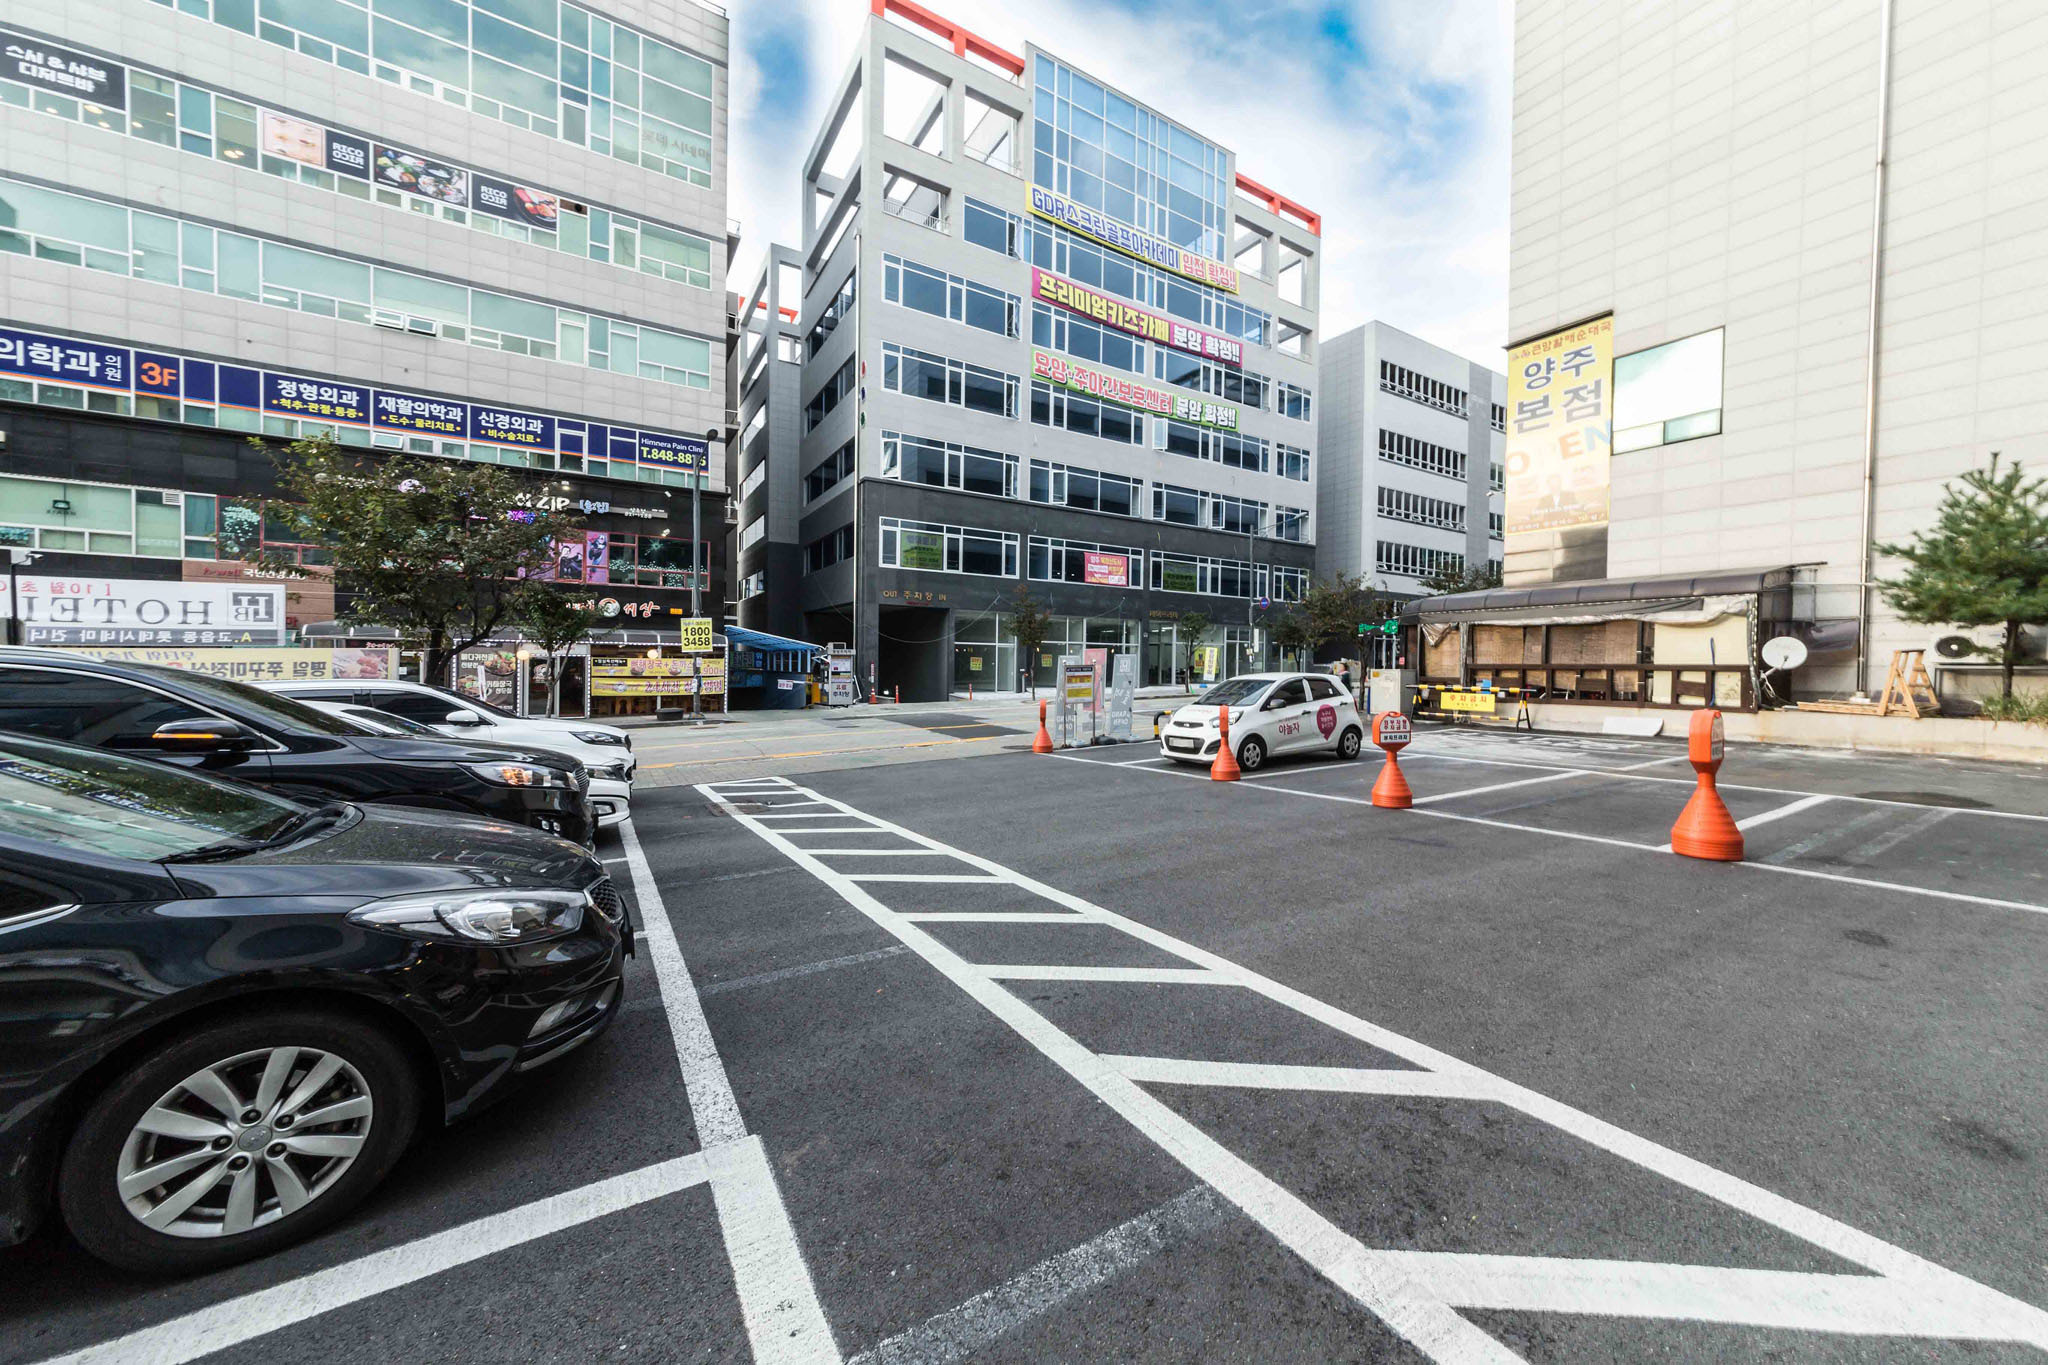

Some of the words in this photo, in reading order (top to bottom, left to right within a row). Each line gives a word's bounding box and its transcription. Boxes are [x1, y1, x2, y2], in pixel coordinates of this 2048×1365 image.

[1032, 187, 1180, 271] GDR스크린골프아카데미
[1182, 252, 1207, 282] 입점
[1207, 263, 1237, 290] 확정!!
[1039, 272, 1171, 343] 프리미엄키즈카페
[1173, 324, 1202, 351] 분양
[1205, 332, 1241, 364] 확정!!
[141, 362, 177, 387] 3F
[1523, 344, 1597, 391] 양주
[277, 380, 360, 407] 정형외과
[1513, 378, 1603, 434] 본점
[378, 395, 464, 423] 재활의학과
[1176, 396, 1204, 422] 분양
[1205, 403, 1236, 429] 확정!!
[478, 411, 544, 434] 신경외과
[672, 442, 688, 451] Pain
[883, 590, 898, 598] OUT
[938, 593, 947, 601] IN
[683, 626, 711, 637] 1800
[683, 637, 711, 647] 3458
[1278, 722, 1300, 736] 야놀자
